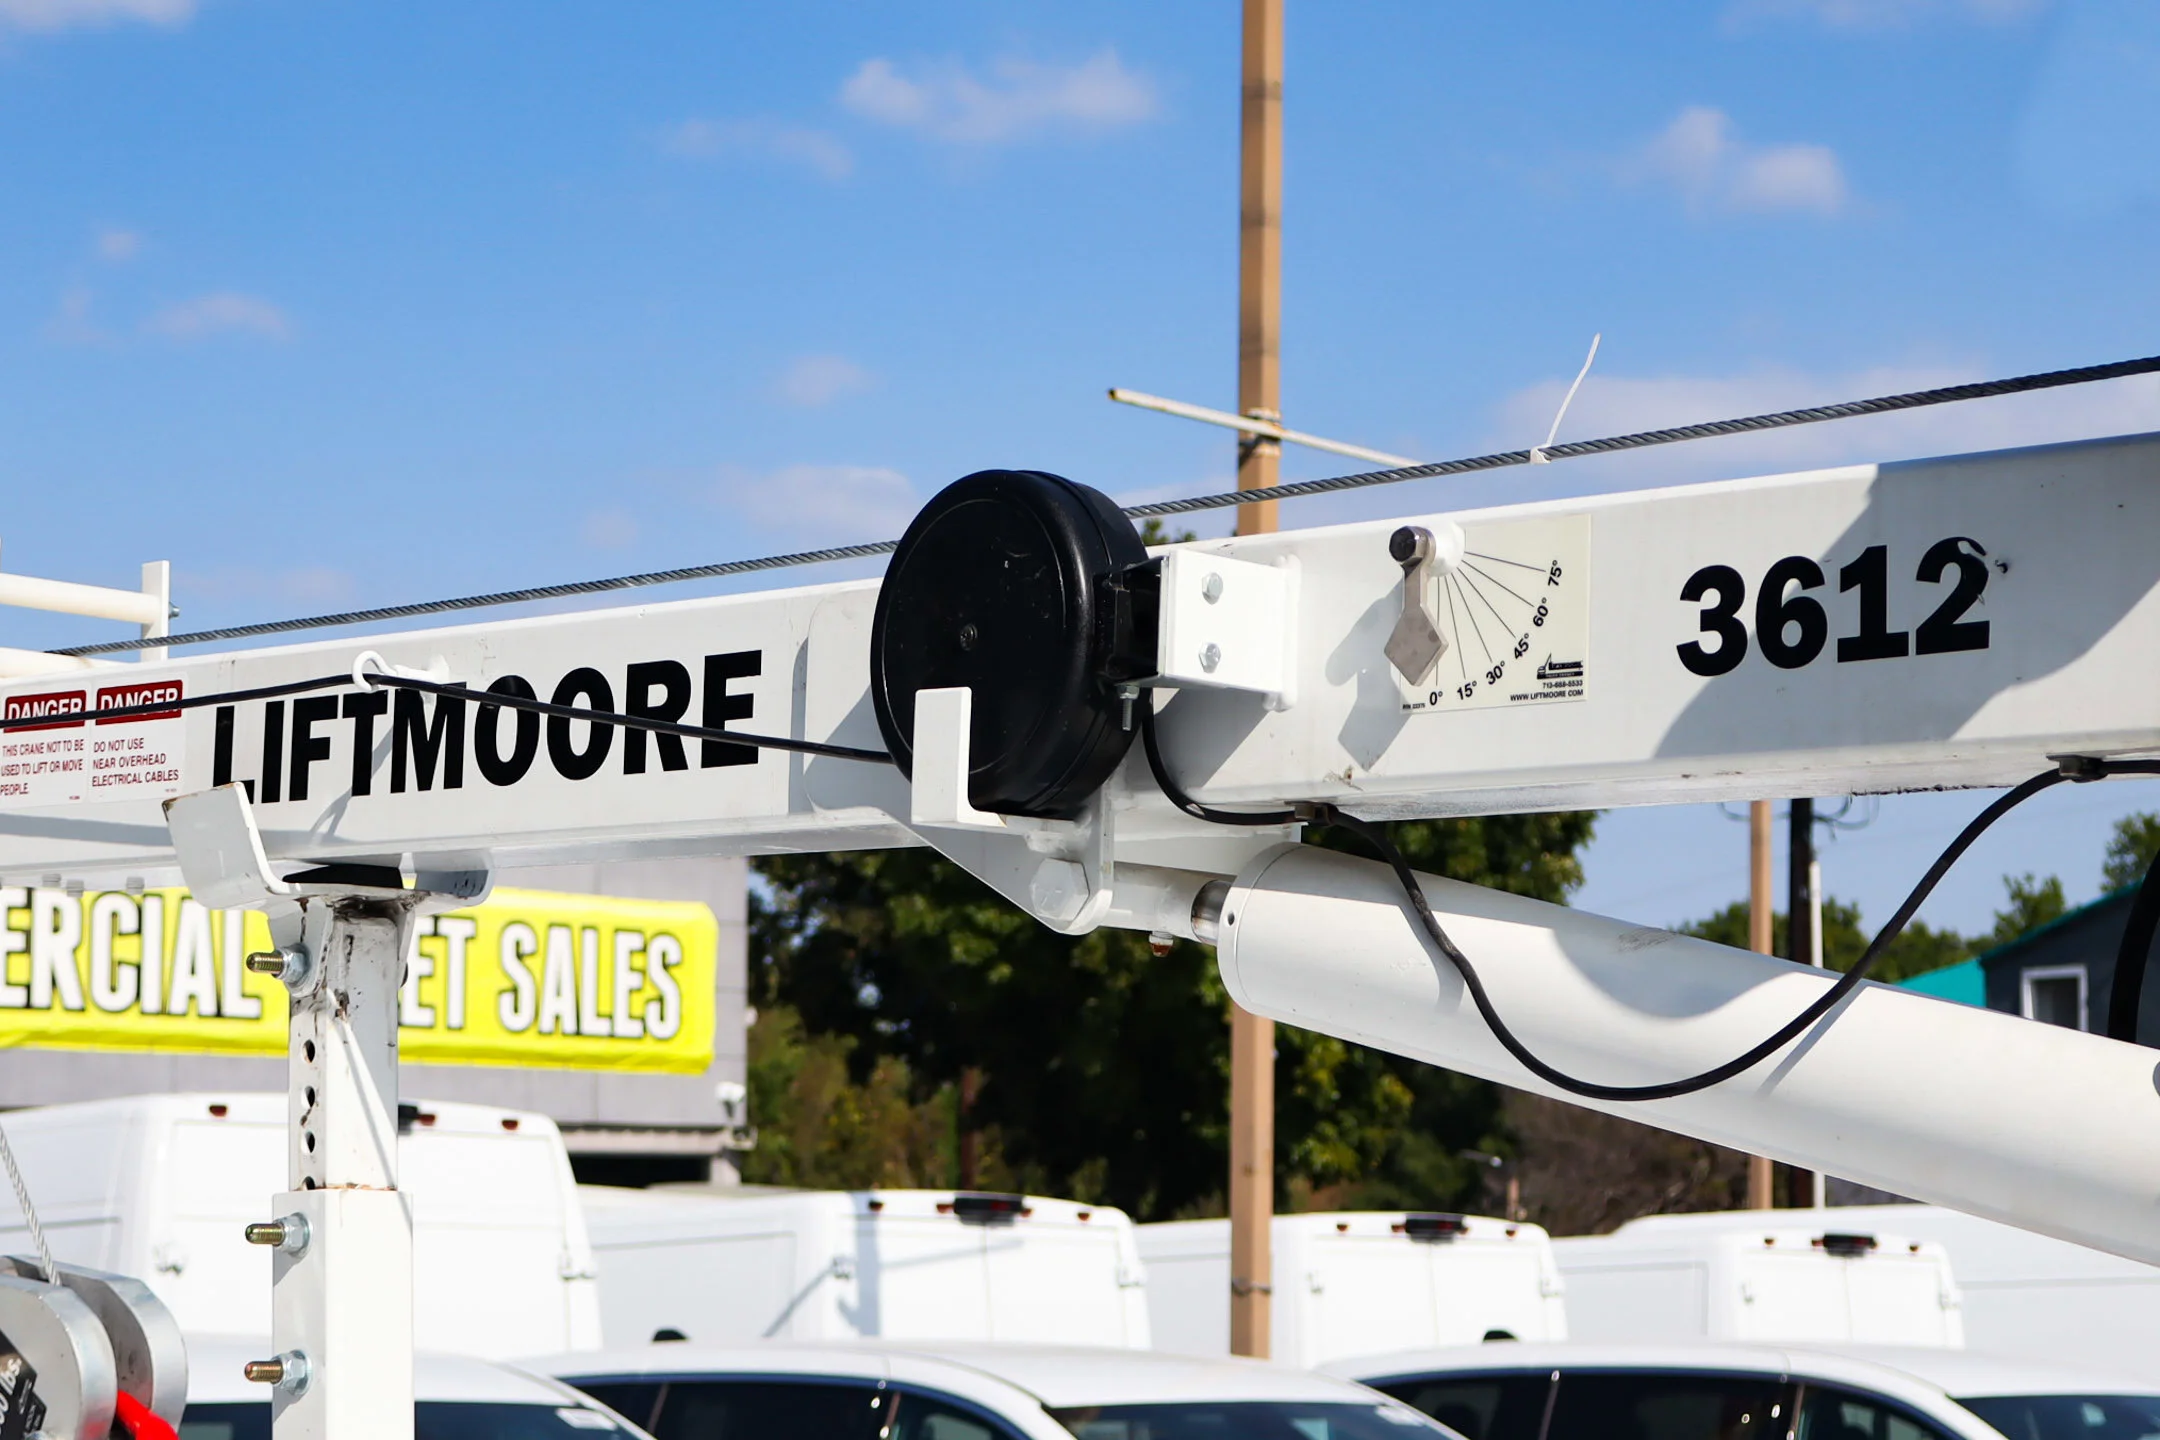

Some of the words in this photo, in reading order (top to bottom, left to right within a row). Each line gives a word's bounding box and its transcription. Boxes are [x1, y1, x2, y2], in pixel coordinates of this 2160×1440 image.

[1548, 560, 1562, 586] 75°
[1533, 597, 1549, 627] 60°
[1676, 536, 1990, 677] 3612
[1514, 633, 1530, 660] 45°
[1486, 661, 1506, 686] 30°
[101, 688, 178, 715] DANGER
[1429, 691, 1443, 706] 0°
[1457, 681, 1478, 701] 15°
[8, 698, 82, 722] DANGER
[213, 649, 763, 805] LIFTMOORE
[3, 745, 18, 757] THIS
[20, 742, 44, 756] CRANE
[47, 741, 62, 753] NOT
[63, 740, 73, 752] TO
[74, 739, 84, 751] BE
[94, 741, 106, 753] DO
[108, 739, 125, 751] NOT
[127, 738, 144, 750] USE
[1, 764, 20, 777] USED
[22, 763, 31, 774] TO
[33, 762, 48, 774] LIFT
[49, 761, 60, 773] OR
[62, 759, 83, 771] MOVE
[93, 757, 116, 770] NEAR
[118, 753, 167, 768] OVERHEAD
[92, 773, 143, 787] ELECTRICAL
[145, 769, 179, 783] CABLES
[498, 920, 684, 1040] SALES
